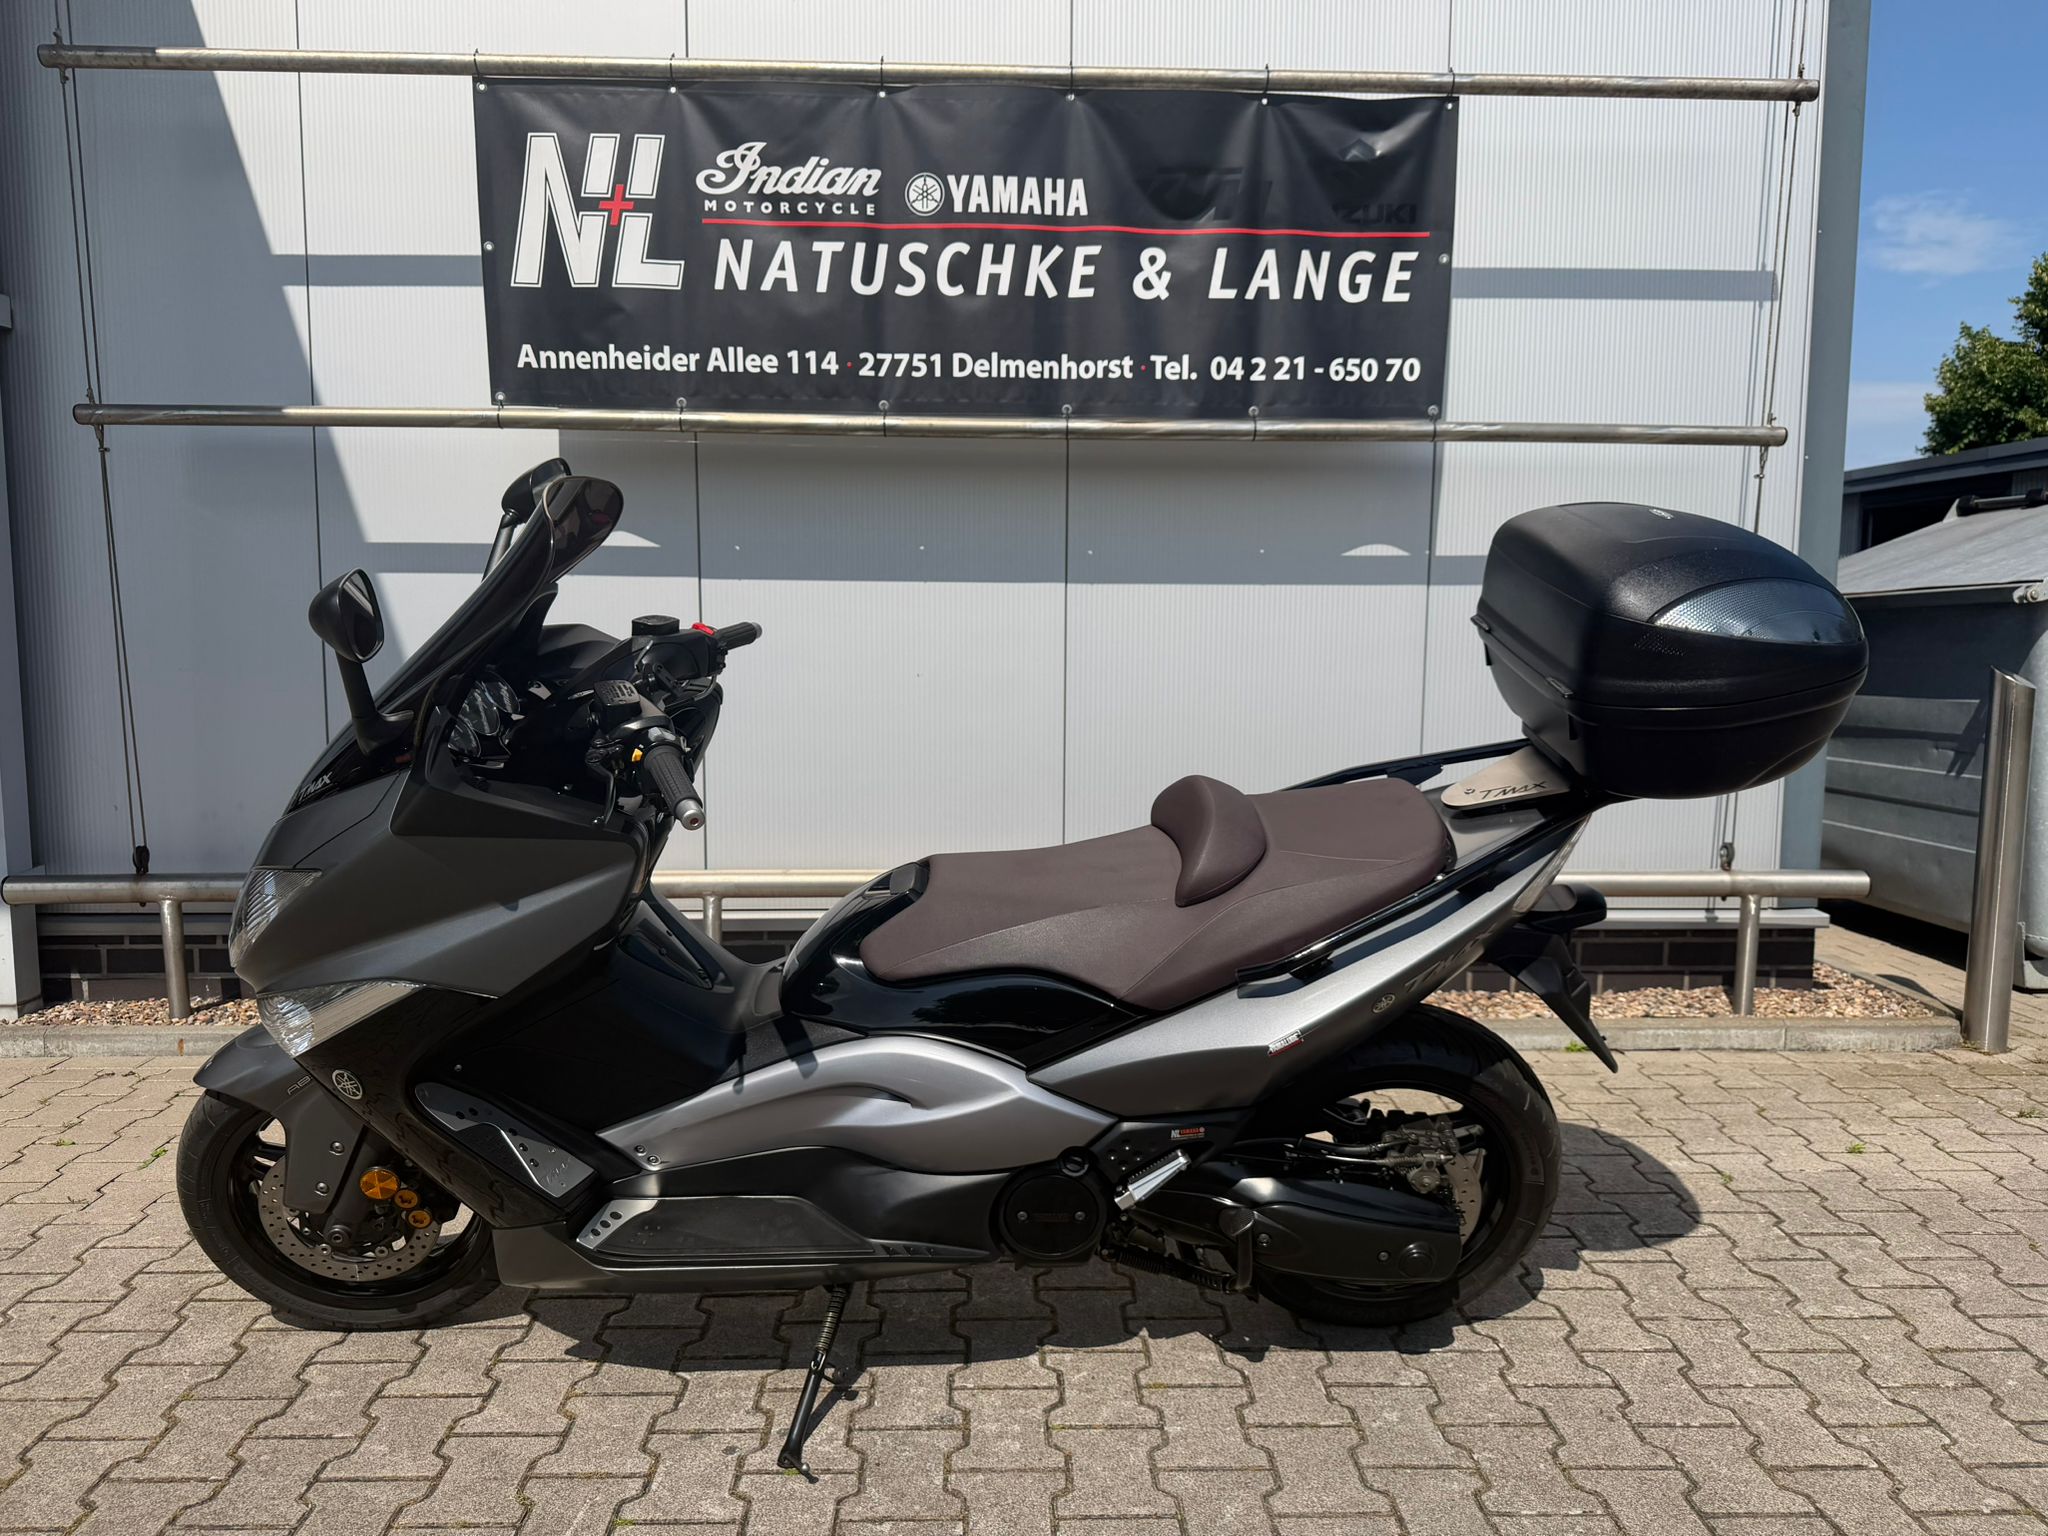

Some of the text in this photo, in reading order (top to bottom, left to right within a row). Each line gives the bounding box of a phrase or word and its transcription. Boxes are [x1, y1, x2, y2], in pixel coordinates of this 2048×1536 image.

[696, 141, 882, 197] Indian
[704, 199, 876, 216] MOTORCYCLE
[946, 174, 1089, 217] YAMAHA
[714, 238, 1419, 304] NATUSCHKE & LANGE
[517, 343, 700, 372] Annenheider
[706, 346, 779, 374] Allee
[787, 349, 839, 376] 114
[858, 351, 942, 378] 27751
[952, 351, 1134, 380] Delmenhorst
[1149, 353, 1198, 381] Tel.
[287, 1074, 313, 1096] AB
